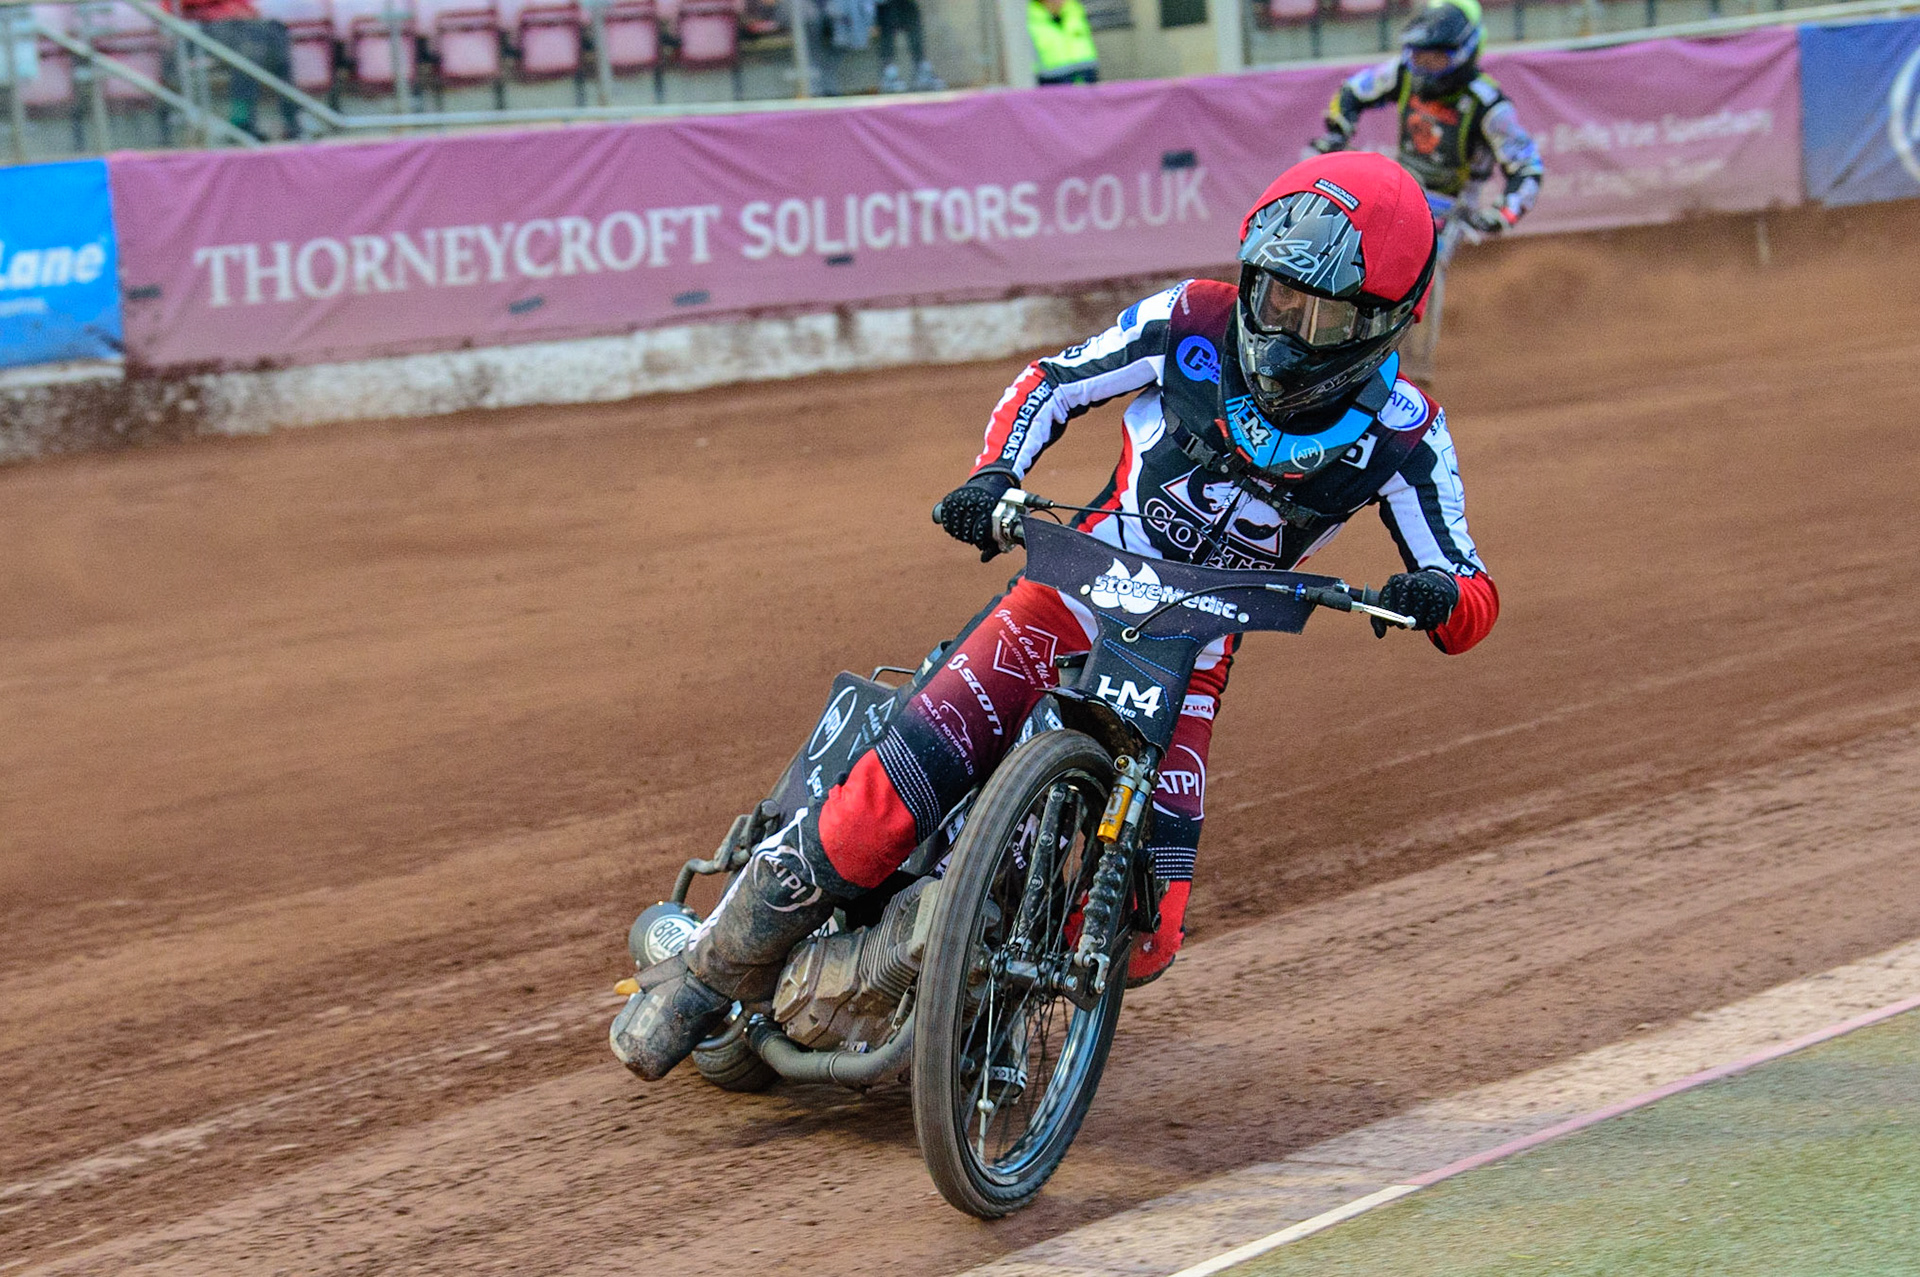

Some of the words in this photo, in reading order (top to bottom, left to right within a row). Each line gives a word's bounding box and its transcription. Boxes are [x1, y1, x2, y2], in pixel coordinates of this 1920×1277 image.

[194, 203, 724, 308] THORNEYCROFT
[738, 167, 1209, 260] SOLICITORS.CO.UK
[1389, 390, 1419, 418] ATPI
[1297, 446, 1319, 461] ATPI
[1096, 675, 1163, 718] HM4
[1183, 704, 1213, 714] ruck
[940, 723, 967, 758] MOTORS
[964, 760, 974, 775] LTD
[765, 855, 807, 900] ATPI
